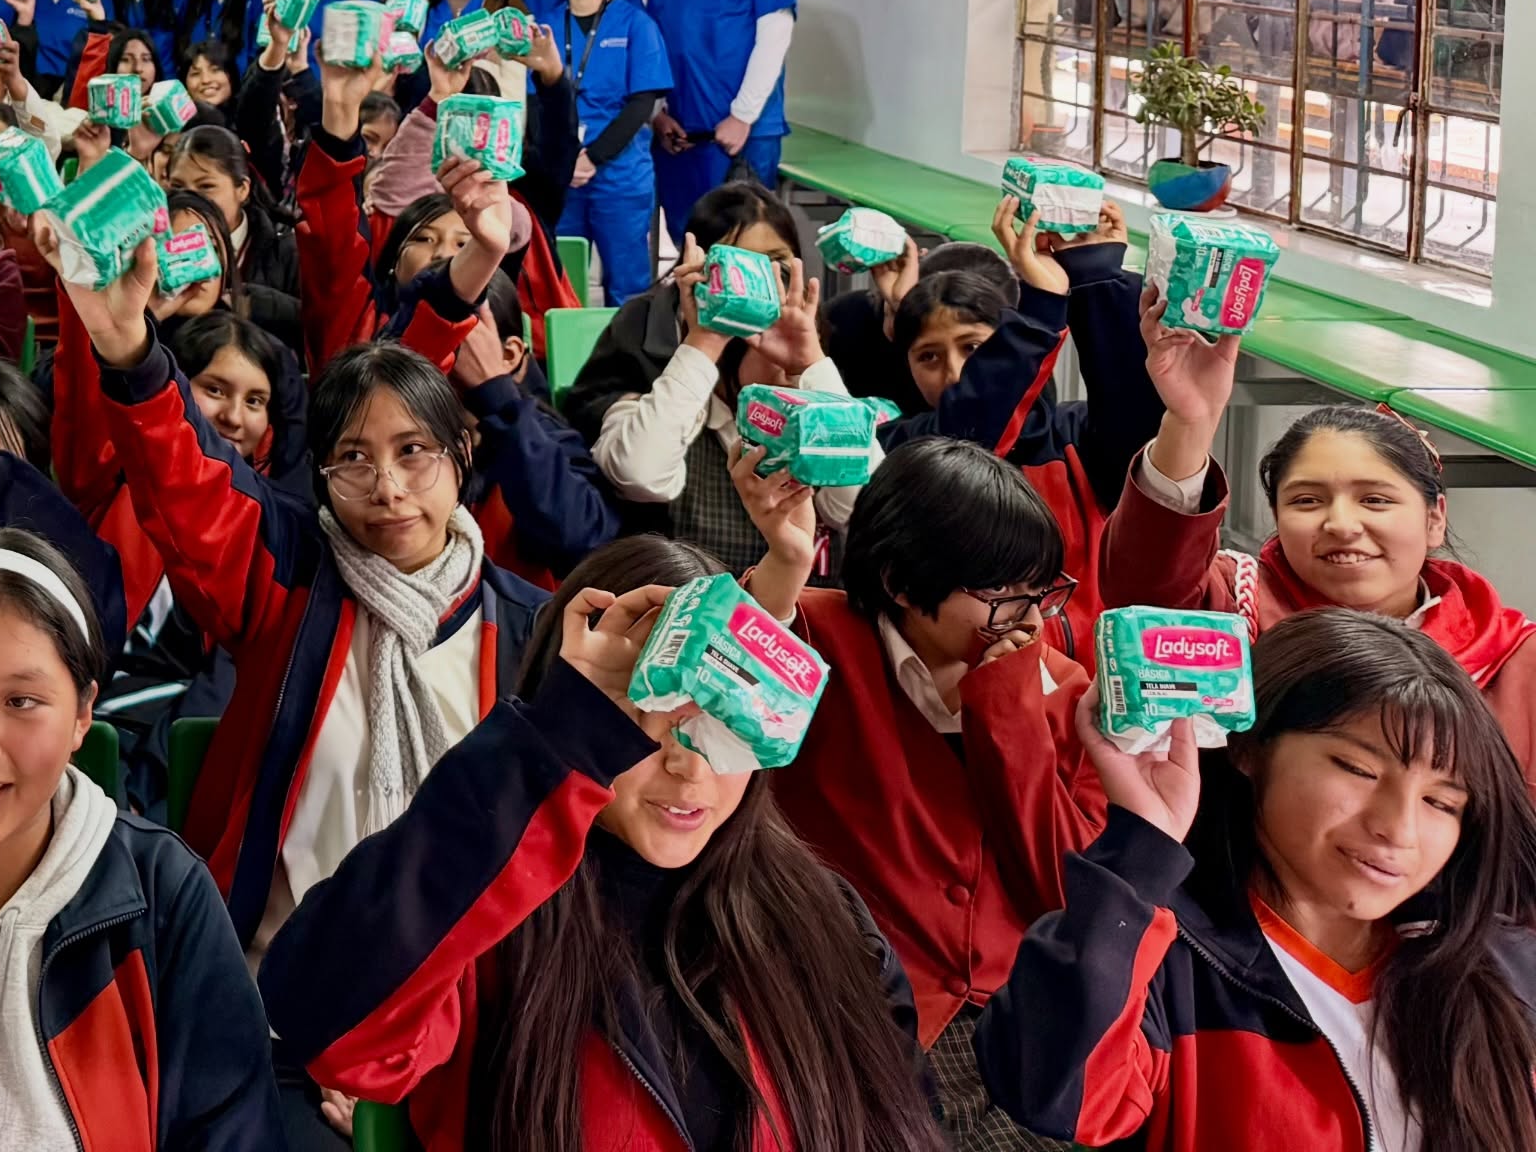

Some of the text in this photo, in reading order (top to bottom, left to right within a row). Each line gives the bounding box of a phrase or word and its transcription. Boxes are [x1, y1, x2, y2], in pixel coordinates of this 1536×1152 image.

[1228, 264, 1259, 322] Ladysoft
[748, 406, 784, 431] Ladysoft
[710, 632, 743, 660] BÁSICA
[737, 615, 815, 681] Ladysoft
[1154, 634, 1231, 660] Ladysoft
[695, 665, 711, 684] 10
[1138, 667, 1170, 680] BÁSICA
[1144, 703, 1158, 716] 10
